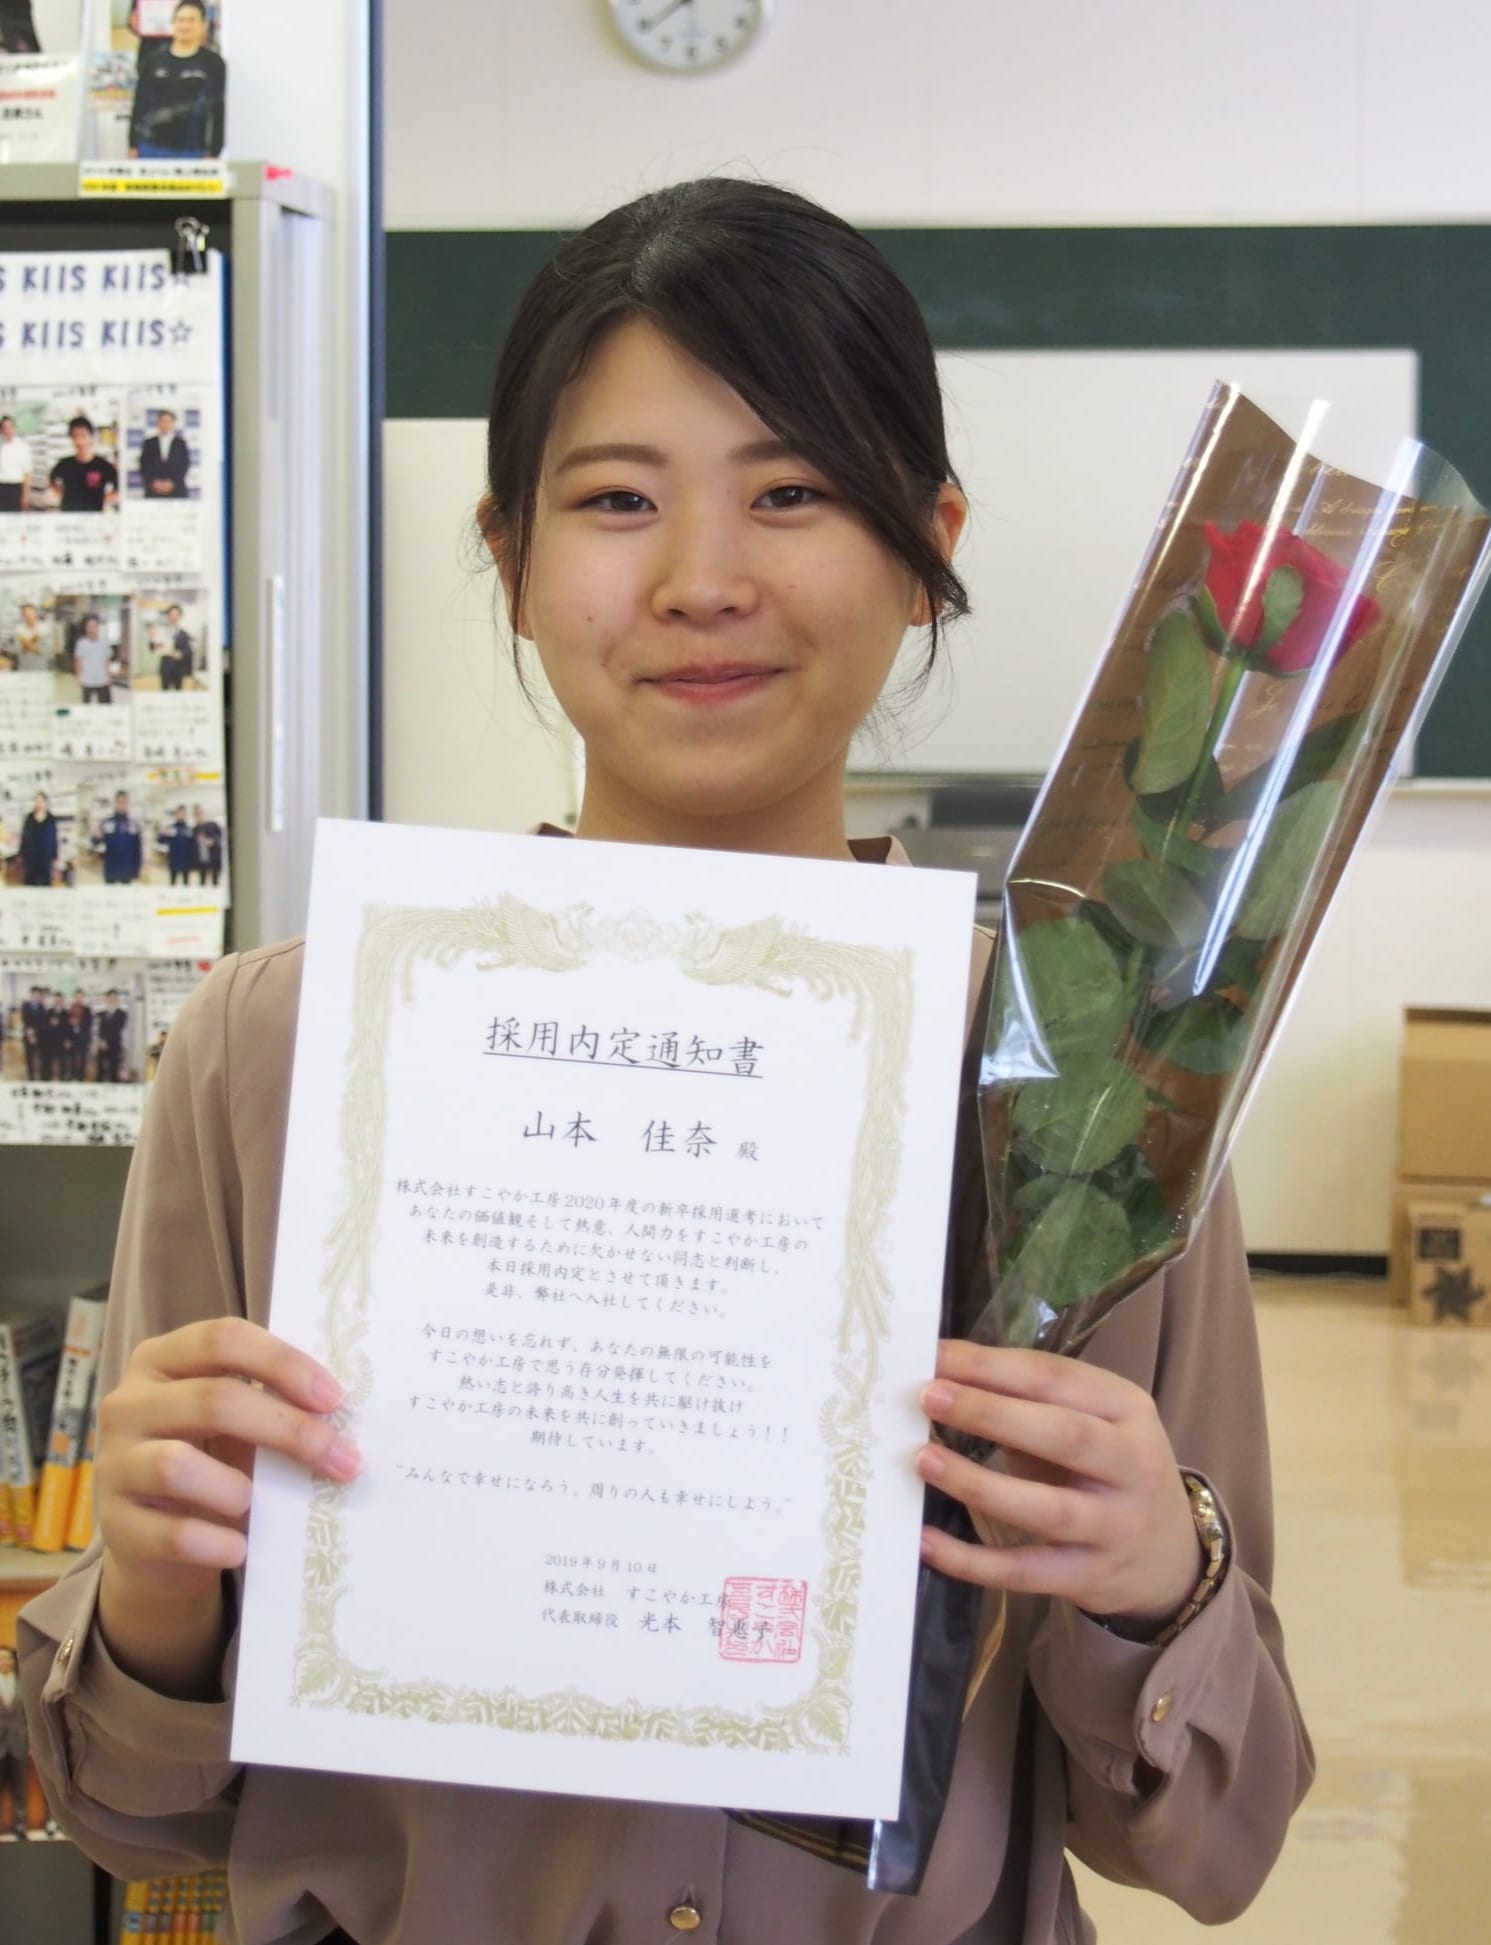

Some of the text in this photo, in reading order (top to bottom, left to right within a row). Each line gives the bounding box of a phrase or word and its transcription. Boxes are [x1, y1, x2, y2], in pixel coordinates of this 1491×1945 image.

[485, 1016, 764, 1077] 採用内定通知書
[523, 1110, 760, 1161] 山本 佳奈 殿
[530, 1430, 655, 1456] 期待しています。
[544, 1579, 605, 1598] 株式会社
[541, 1607, 619, 1629] 代表取締役
[640, 1611, 682, 1635] 光本
